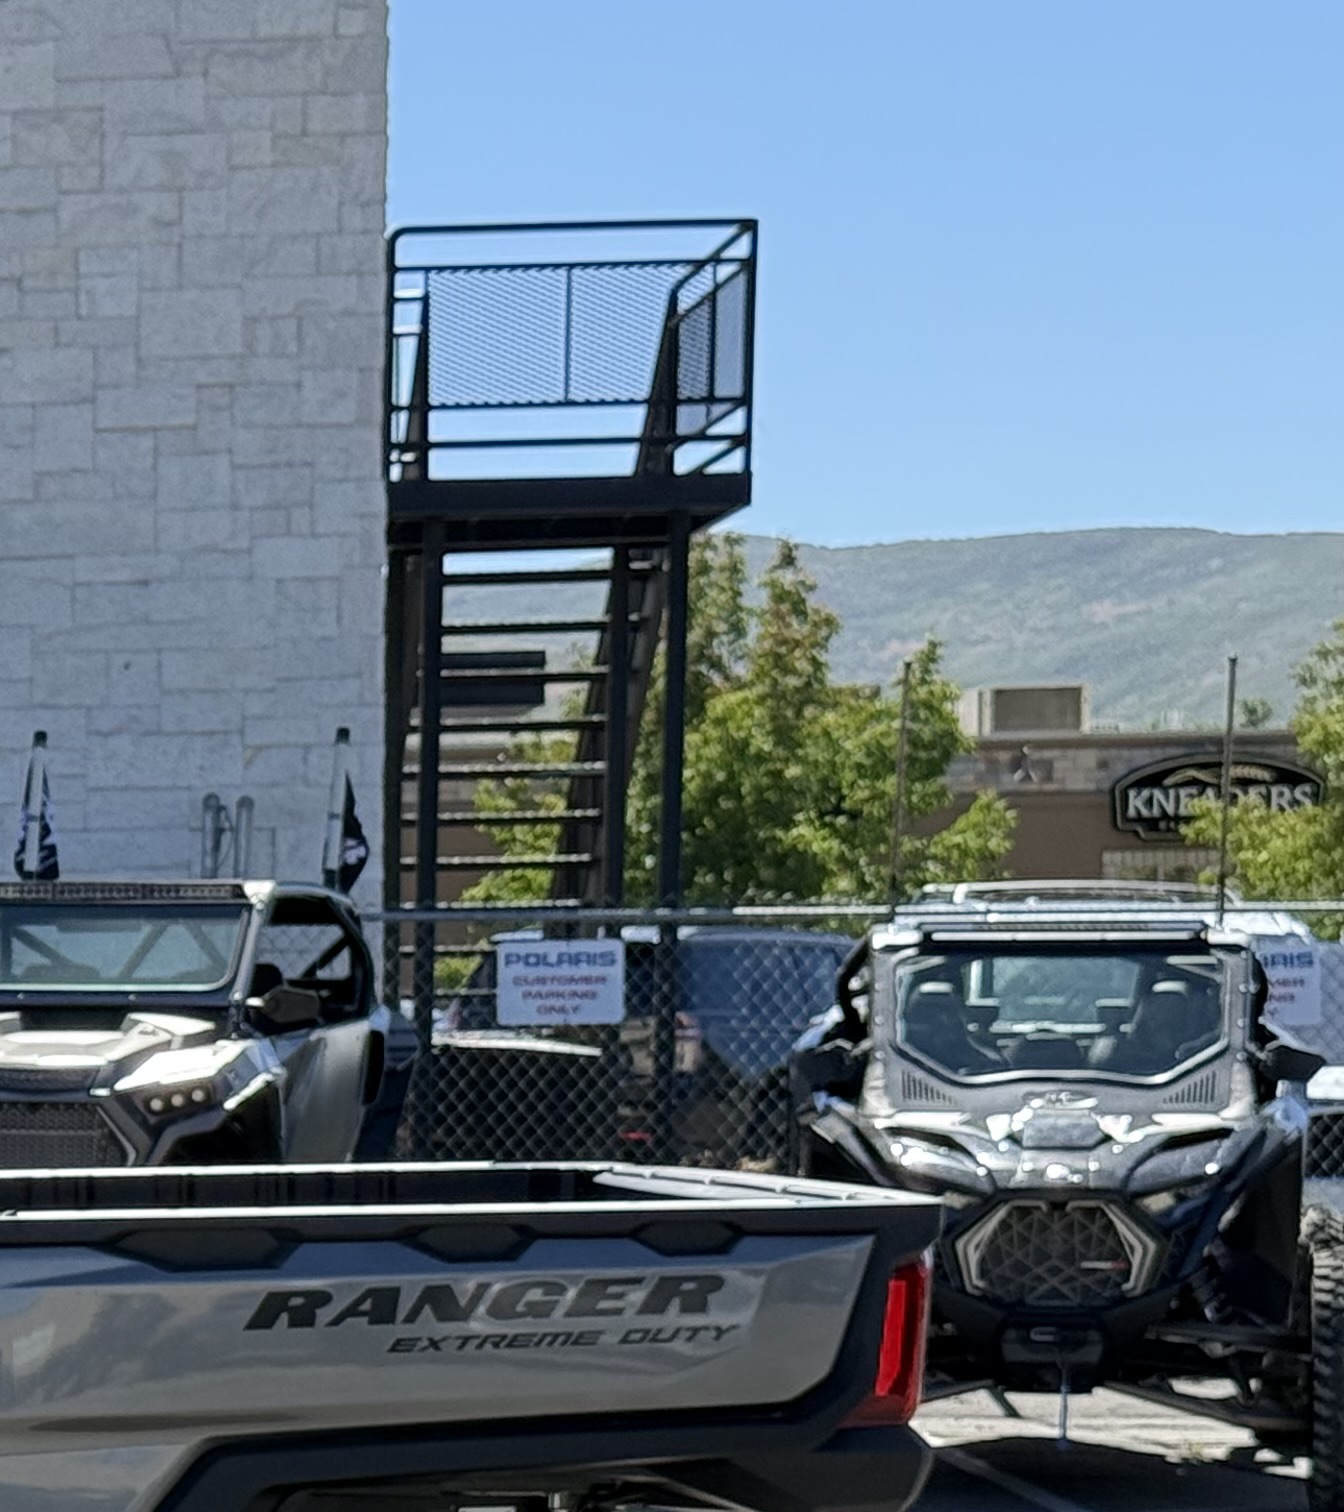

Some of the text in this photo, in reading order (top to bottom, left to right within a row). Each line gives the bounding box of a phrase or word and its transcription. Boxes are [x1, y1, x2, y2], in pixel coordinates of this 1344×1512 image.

[504, 950, 617, 967] POLARIS
[513, 974, 607, 987] CUSTOMER
[522, 989, 598, 1001] PARKING
[535, 1003, 581, 1015] ONLY
[243, 1274, 726, 1331] RANGER
[386, 1323, 740, 1354] EXTREME DUTY
